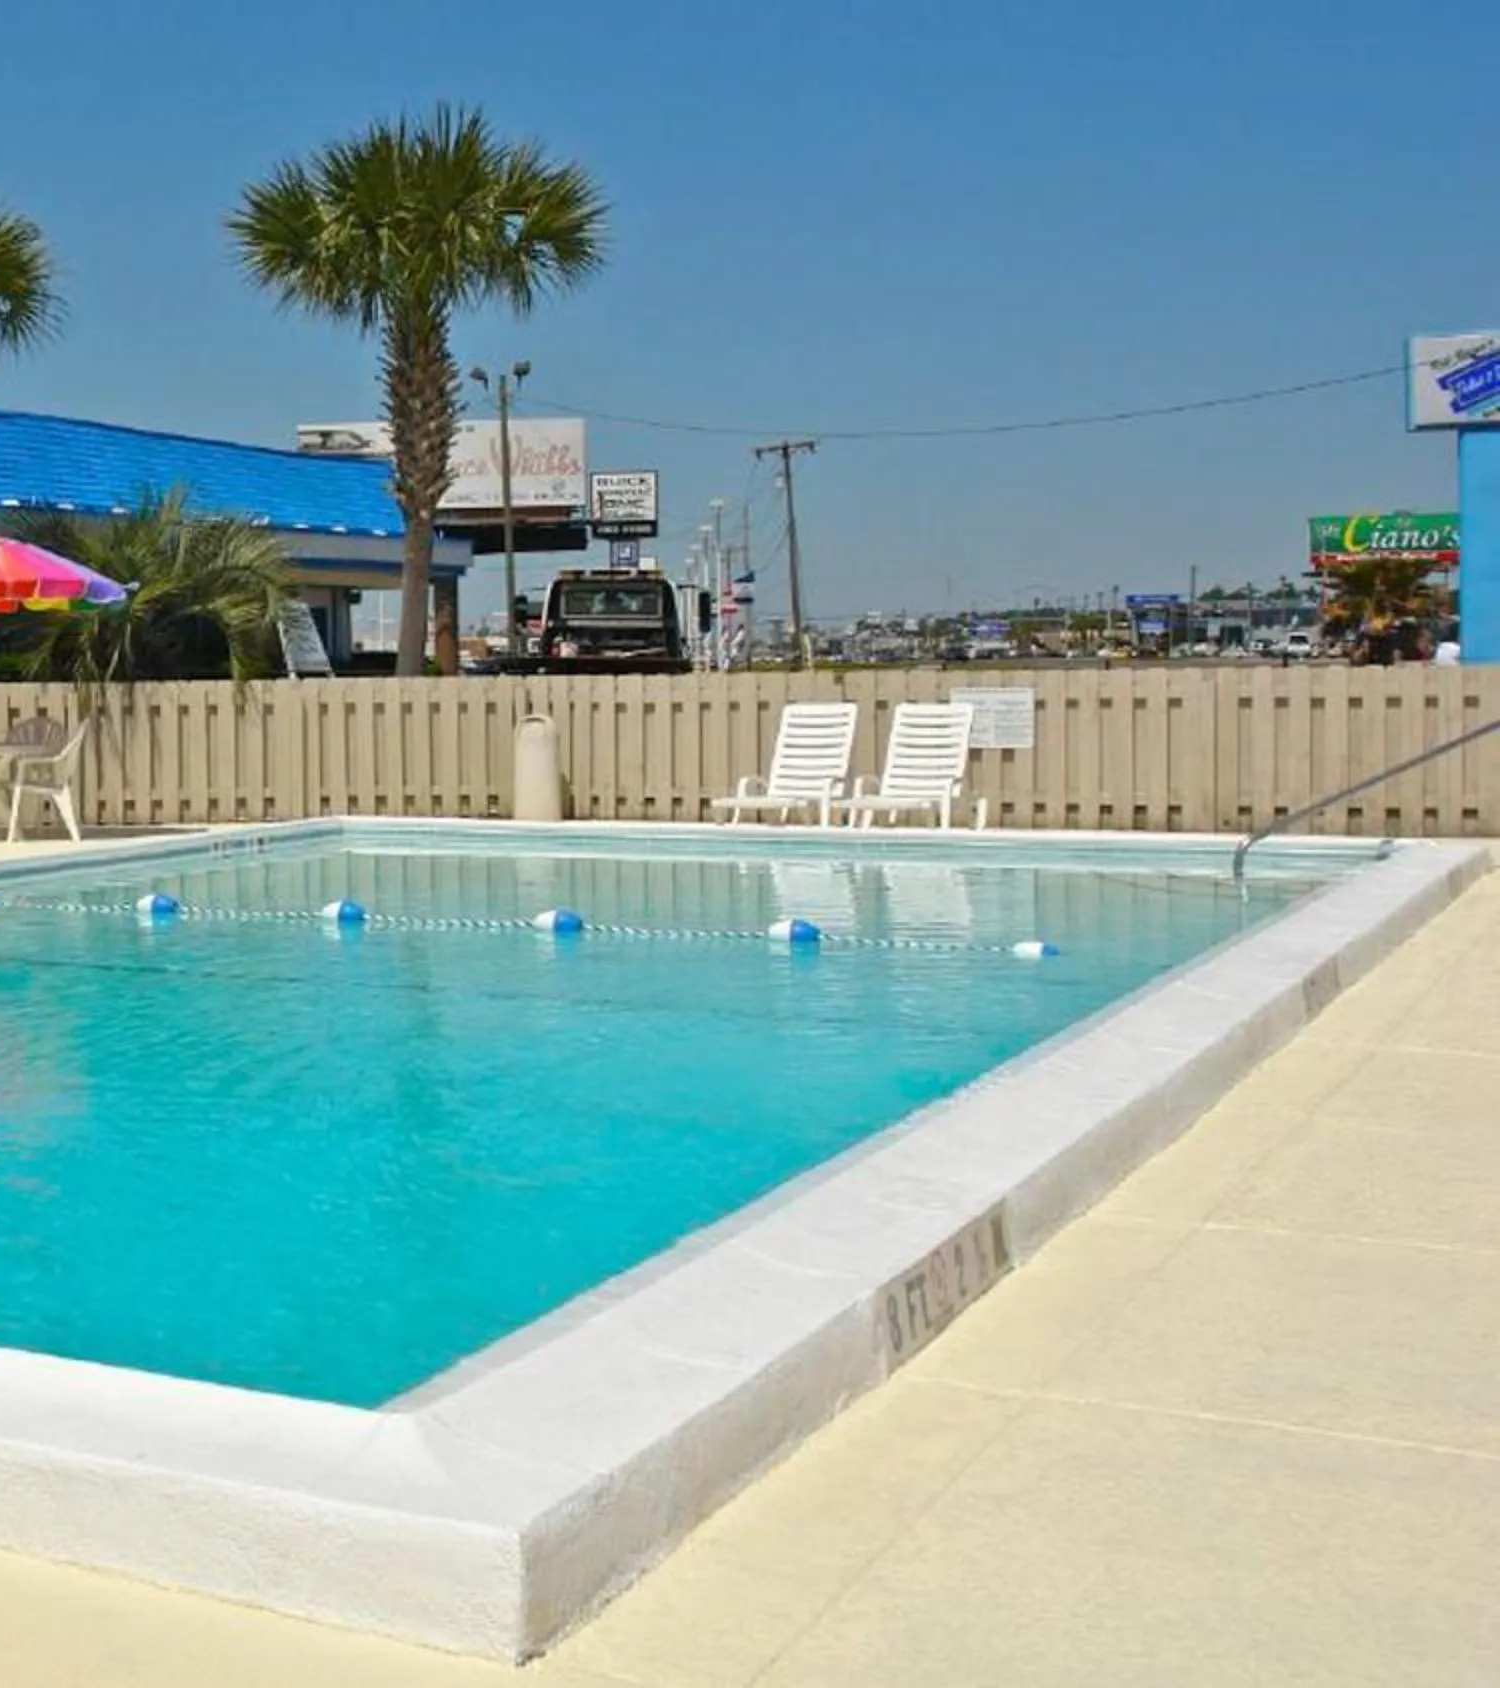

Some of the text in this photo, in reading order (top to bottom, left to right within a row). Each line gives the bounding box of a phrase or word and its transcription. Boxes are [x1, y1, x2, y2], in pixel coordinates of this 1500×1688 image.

[1344, 512, 1461, 552] Ciano's
[886, 1293, 903, 1352] 8
[905, 1273, 933, 1341] FT
